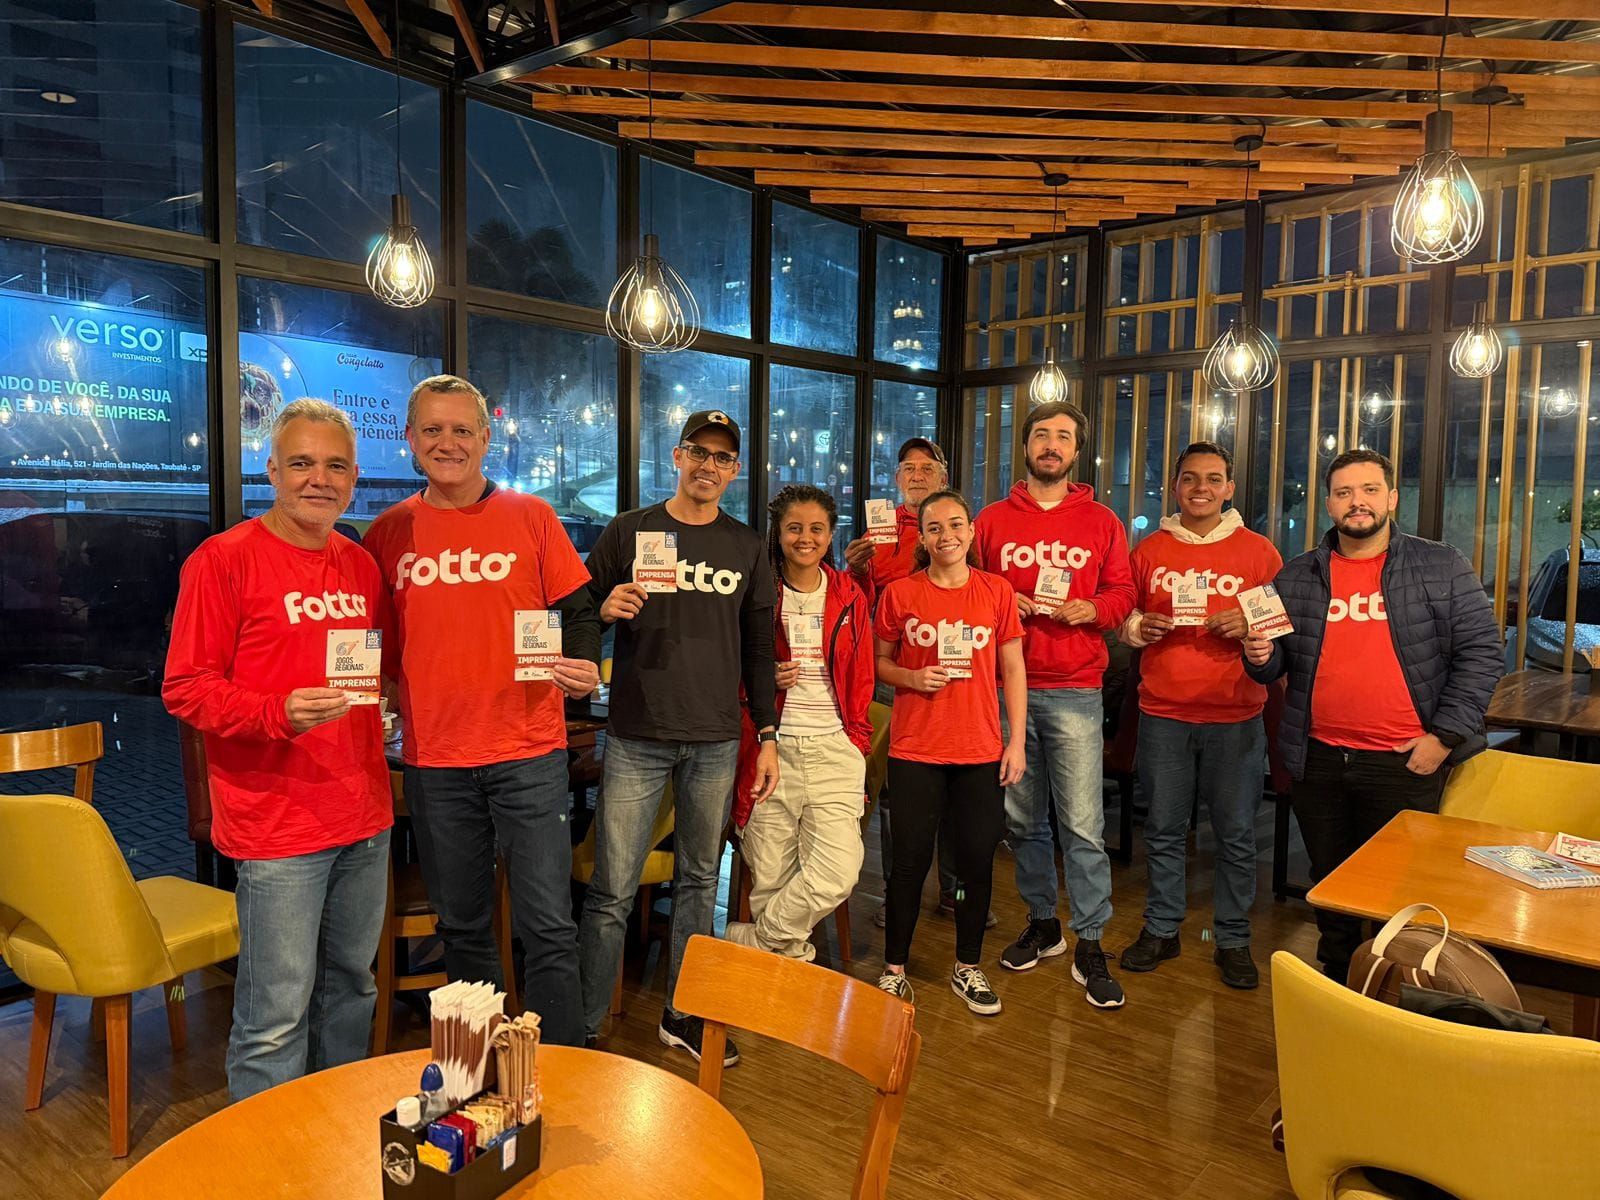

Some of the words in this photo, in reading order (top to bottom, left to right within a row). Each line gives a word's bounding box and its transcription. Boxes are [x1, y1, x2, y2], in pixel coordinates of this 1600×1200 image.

[50, 315, 163, 352] verso
[112, 352, 162, 363] INVESTIMENTOS
[38, 379, 62, 394] DE
[64, 381, 114, 400] VOCÊ,
[117, 386, 139, 401] DA
[141, 388, 172, 403] SUA
[333, 389, 377, 408] Entre
[381, 398, 390, 409] e
[95, 404, 171, 422] EMPRESA.
[363, 412, 397, 425] essa
[74, 460, 86, 468] 521
[92, 460, 116, 469] Jardim
[118, 461, 130, 469] das
[1001, 540, 1092, 571] fotto
[396, 547, 517, 590] fotto
[1327, 591, 1388, 622] ott
[905, 617, 992, 650] foo
[335, 663, 364, 672] REGIONAIS
[336, 656, 353, 664] JOGOS
[328, 678, 377, 688] IMPRENSA
